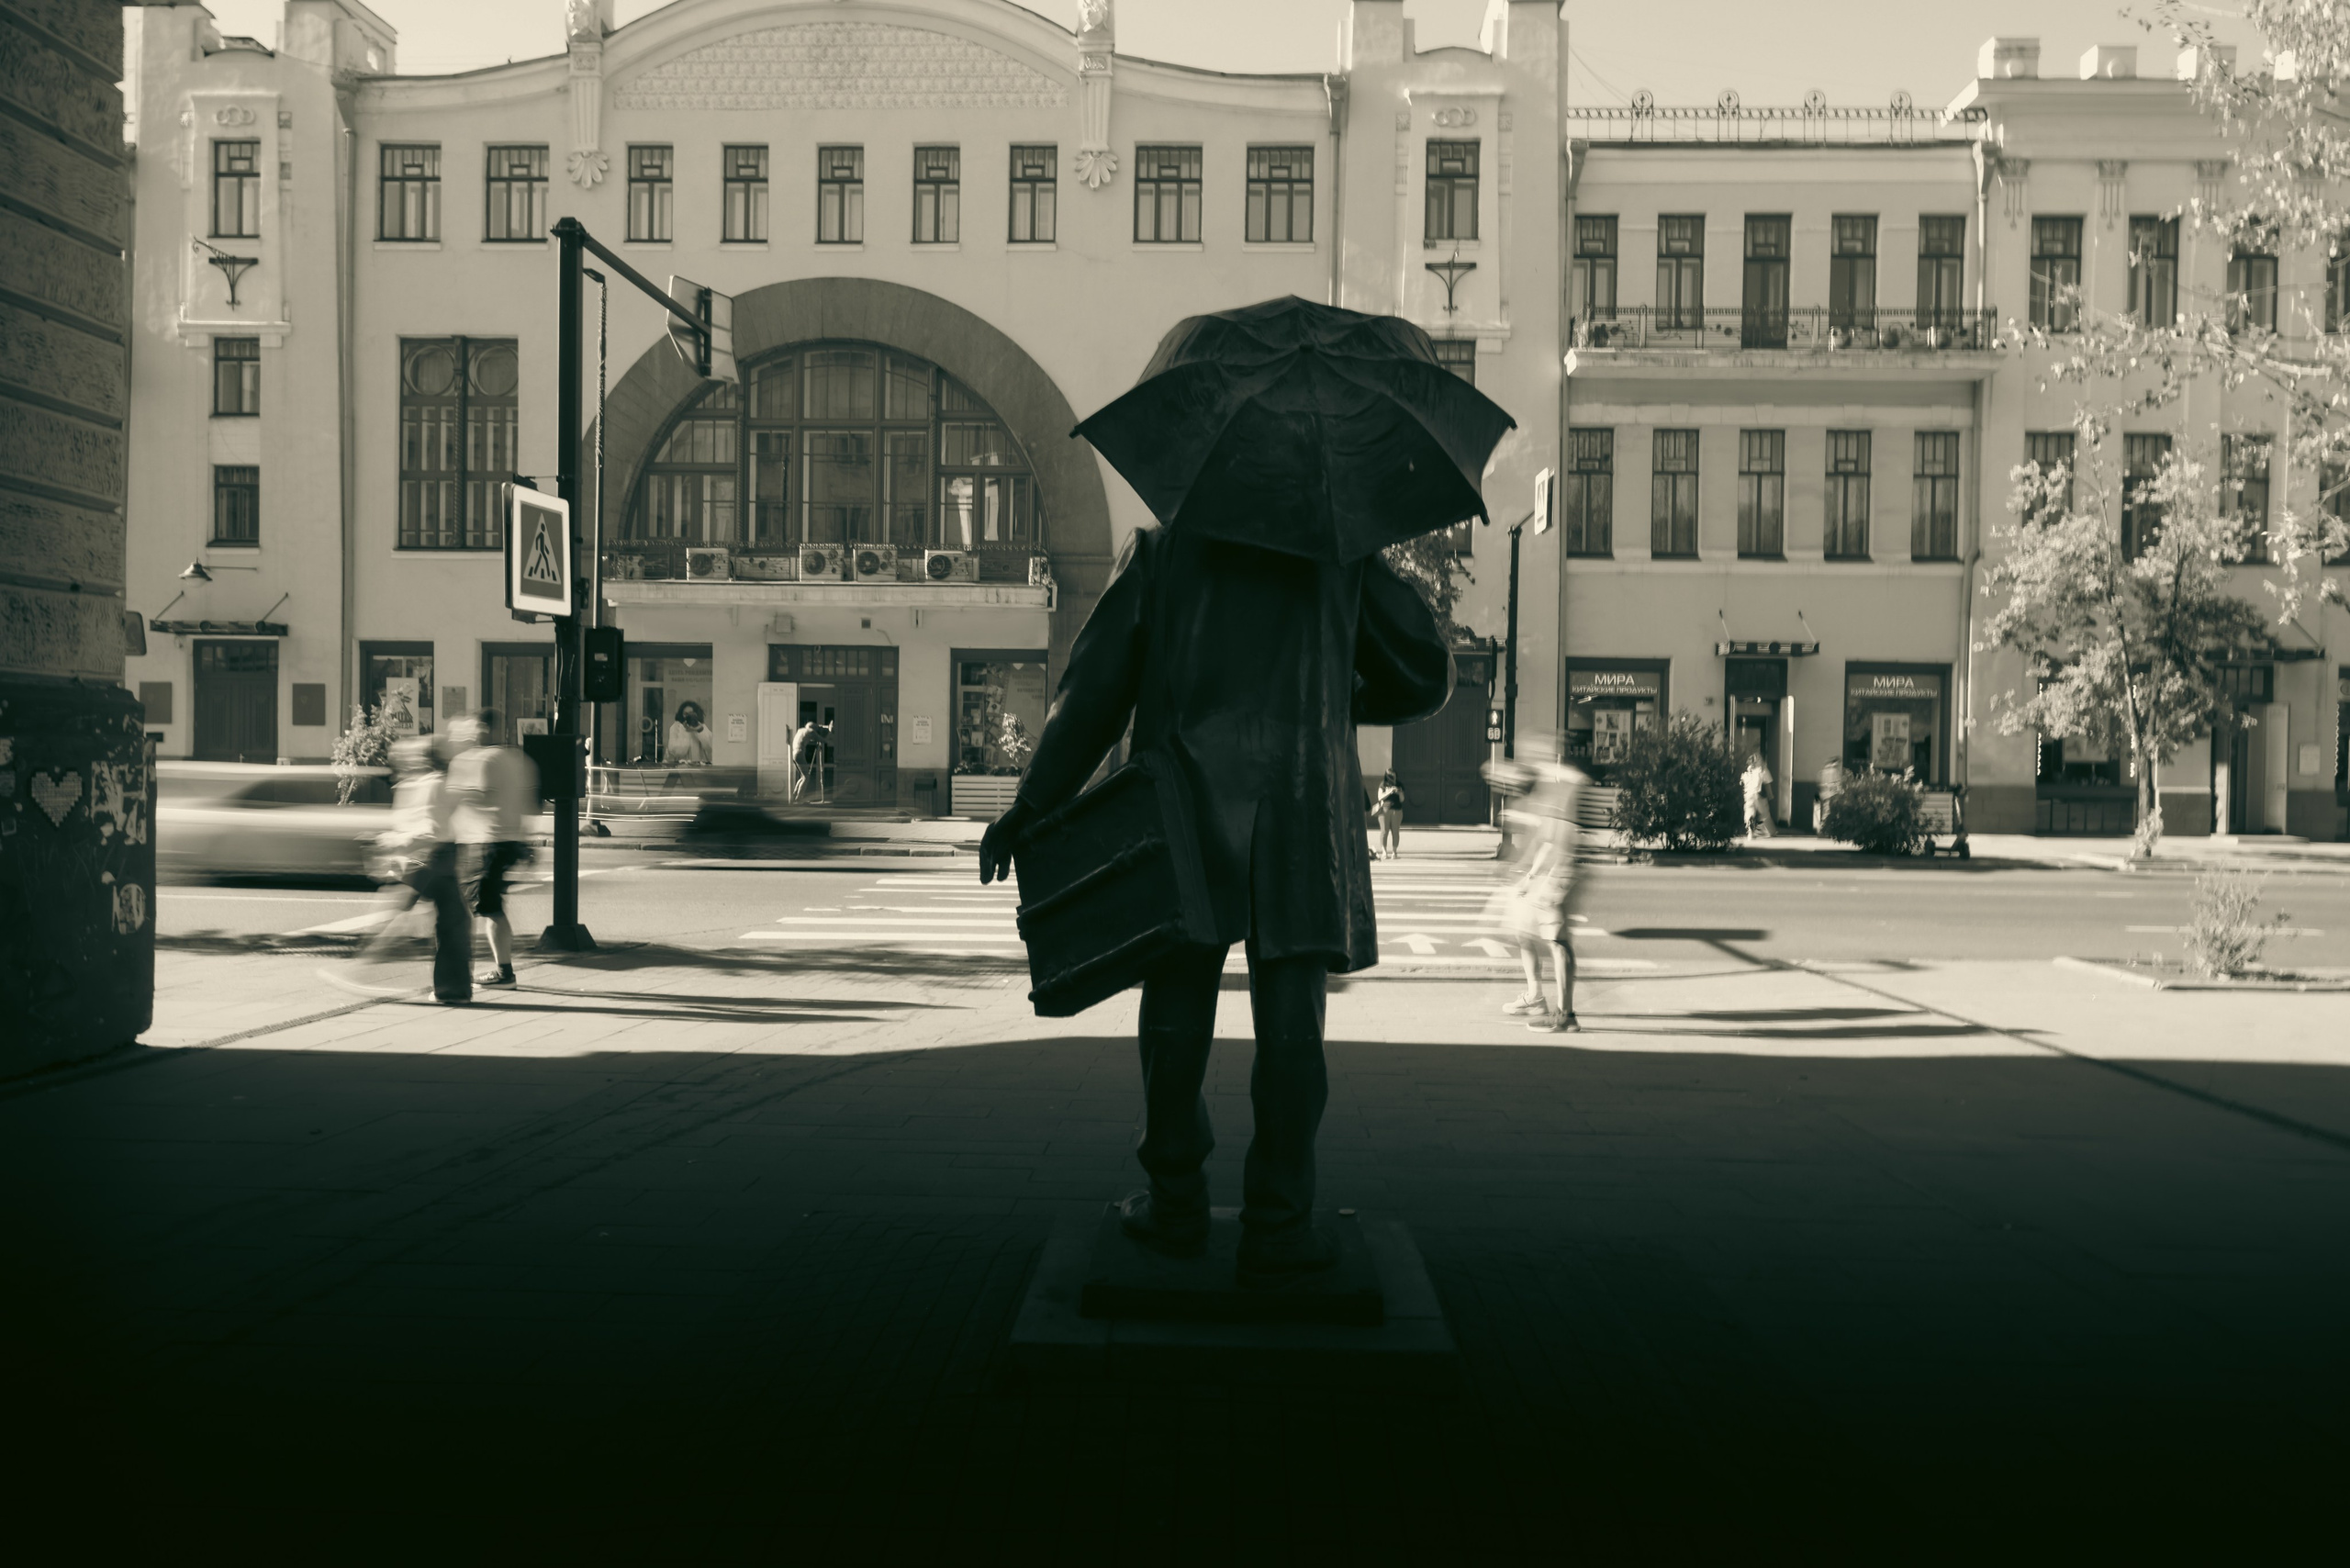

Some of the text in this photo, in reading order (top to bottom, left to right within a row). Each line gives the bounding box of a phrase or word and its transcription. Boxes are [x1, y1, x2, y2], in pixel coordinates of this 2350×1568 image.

[1595, 673, 1635, 685] МИРА
[1874, 676, 1914, 688] МИРА
[1572, 685, 1658, 694] КИТАЙСКИЕ ПРОДУКТЫ
[1851, 687, 1938, 697] КИТАЙСКИЕ ПРОДУКТЫ
